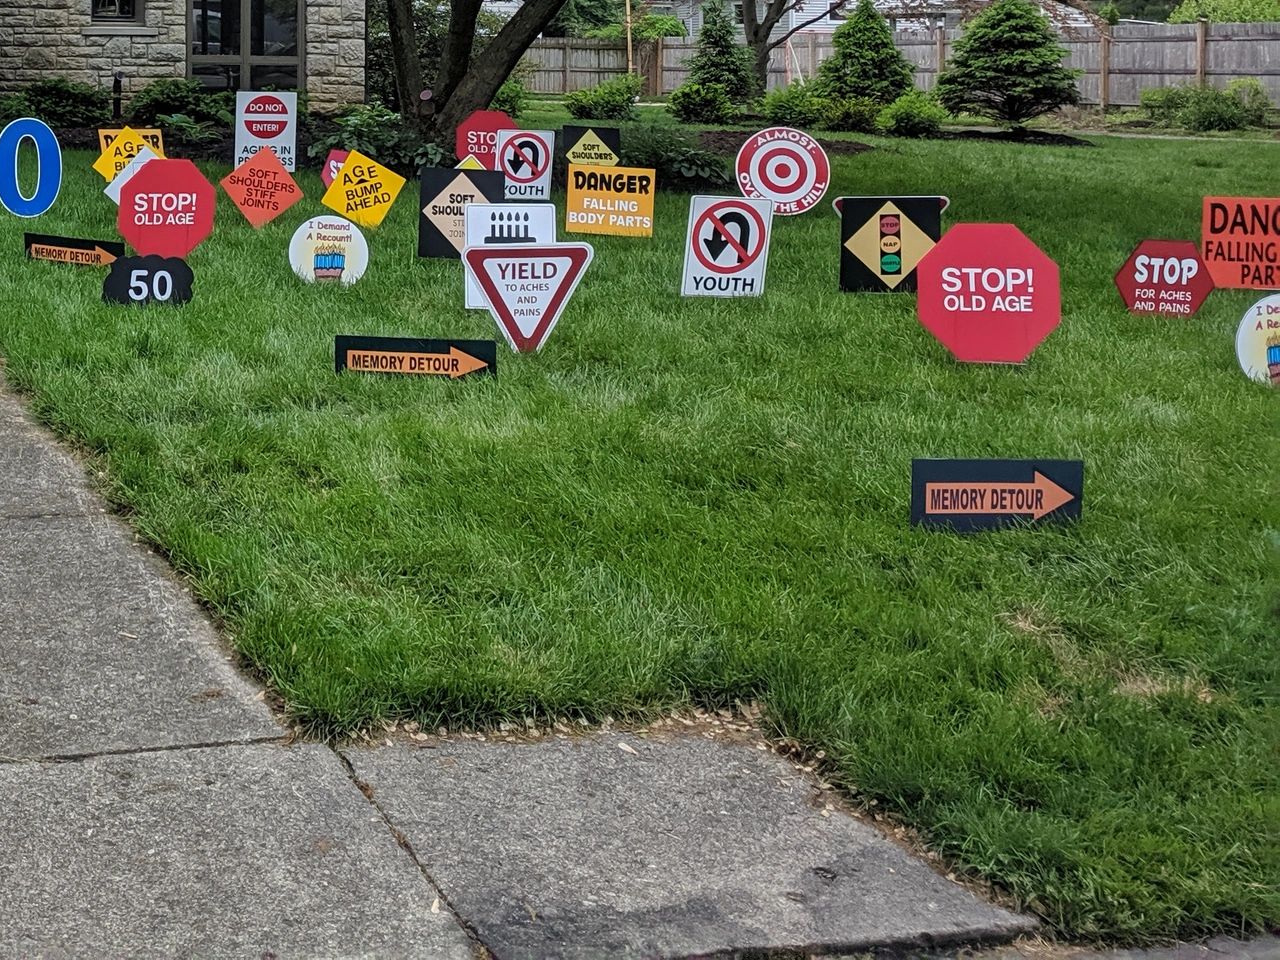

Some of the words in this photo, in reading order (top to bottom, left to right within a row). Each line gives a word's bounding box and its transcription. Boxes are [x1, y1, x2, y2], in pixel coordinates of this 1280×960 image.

[249, 104, 264, 112] DO
[265, 104, 283, 112] NOT
[252, 124, 279, 132] ENTER!
[467, 131, 497, 144] STO
[281, 146, 291, 154] IN
[583, 144, 600, 152] SOFT
[572, 152, 613, 160] SHOULDERS
[249, 168, 278, 180] SOFT
[343, 165, 378, 186] AGE
[229, 175, 295, 194] SHOULDERS
[574, 171, 651, 195] DANGER
[246, 188, 276, 200] STIFF
[345, 182, 383, 201] BUMP
[740, 172, 766, 199] OVE
[774, 202, 799, 213] THE
[801, 182, 825, 207] HILL
[134, 193, 197, 211] STOP!
[240, 197, 279, 211] JOINTS
[345, 192, 391, 214] AHEAD
[449, 194, 475, 204] SOFT
[583, 198, 638, 212] FALLING
[432, 205, 464, 216] SHOUL
[135, 213, 163, 225] OLD
[166, 213, 195, 225] AGE
[309, 221, 314, 229] I
[317, 222, 350, 231] Demand
[569, 212, 605, 224] BODY
[609, 215, 651, 228] PARTS
[1210, 203, 1280, 235] DAN
[306, 232, 313, 240] A
[316, 232, 352, 242] Recount!
[449, 230, 465, 238] JOIN
[34, 247, 67, 260] MEMORY
[70, 251, 102, 264] DETOUR
[1205, 241, 1277, 263] FALLING
[497, 262, 558, 280] YIELD
[1134, 254, 1198, 285] STOP
[1241, 264, 1280, 285] PAR
[128, 269, 173, 301] 50
[693, 276, 754, 292] YOUTH
[942, 267, 1034, 292] STOP!
[505, 284, 517, 292] TO
[520, 283, 549, 292] ACHES
[517, 296, 537, 304] AND
[1135, 289, 1155, 299] FOR
[1159, 290, 1192, 301] ACHES
[943, 295, 986, 311] OLD
[991, 295, 1033, 312] AGE
[1134, 301, 1155, 311] AND
[1159, 302, 1190, 313] PAINS
[514, 308, 540, 316] PAINS
[1256, 320, 1263, 330] A
[352, 354, 405, 369] MEMORY
[409, 356, 459, 372] DETOUR
[931, 488, 986, 510] MEMORY
[990, 488, 1043, 510] DETOUR
